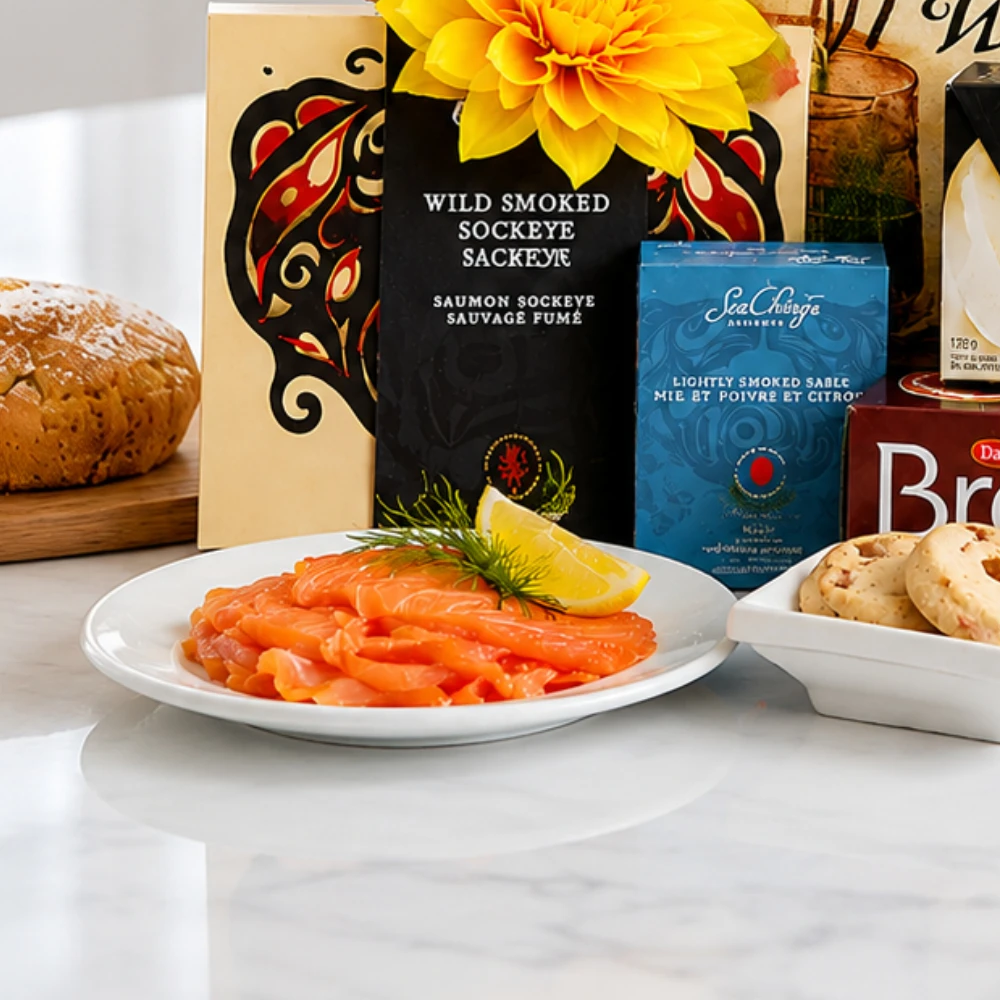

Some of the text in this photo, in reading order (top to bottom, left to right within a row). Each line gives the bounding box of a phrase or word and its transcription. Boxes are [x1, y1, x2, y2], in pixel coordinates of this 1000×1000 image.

[423, 193, 610, 213] WILD SMOKED
[458, 220, 575, 240] SOCKEYE
[433, 295, 596, 308] SAUMON SOCKEYE
[447, 312, 526, 325] SAUVAGE
[739, 377, 800, 388] SMOKED
